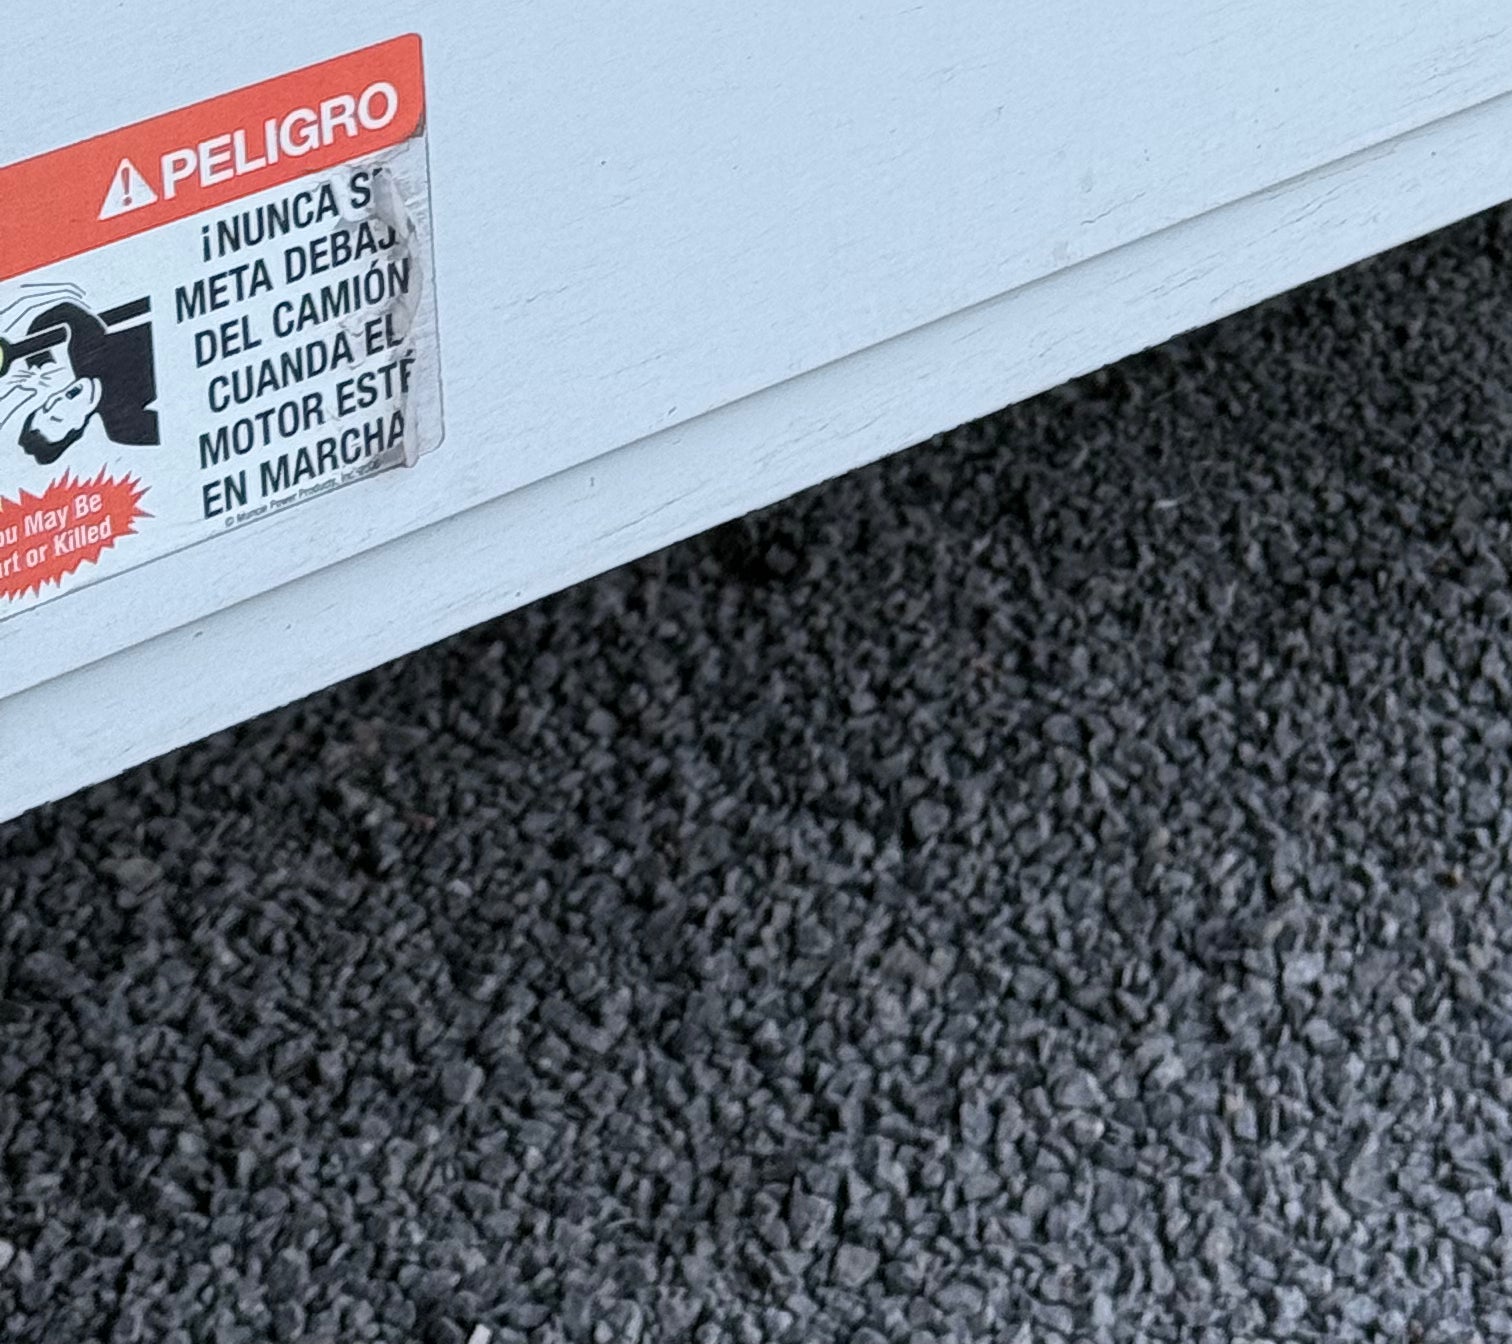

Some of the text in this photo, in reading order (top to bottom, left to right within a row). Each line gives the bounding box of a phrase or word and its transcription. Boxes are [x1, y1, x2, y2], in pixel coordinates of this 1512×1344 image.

[160, 81, 398, 200] PELIGRO
[201, 167, 383, 262] ¡NUNCA S
[175, 221, 399, 324] META DEBAJ
[195, 257, 409, 368] DEL CAMIÓN
[208, 313, 403, 413] CUANDA EL
[198, 392, 325, 469] MOTOR
[202, 410, 404, 519] EN MARCHA
[24, 505, 69, 537] May
[74, 493, 103, 519] Be
[25, 544, 48, 568] or
[53, 515, 112, 556] Killed
